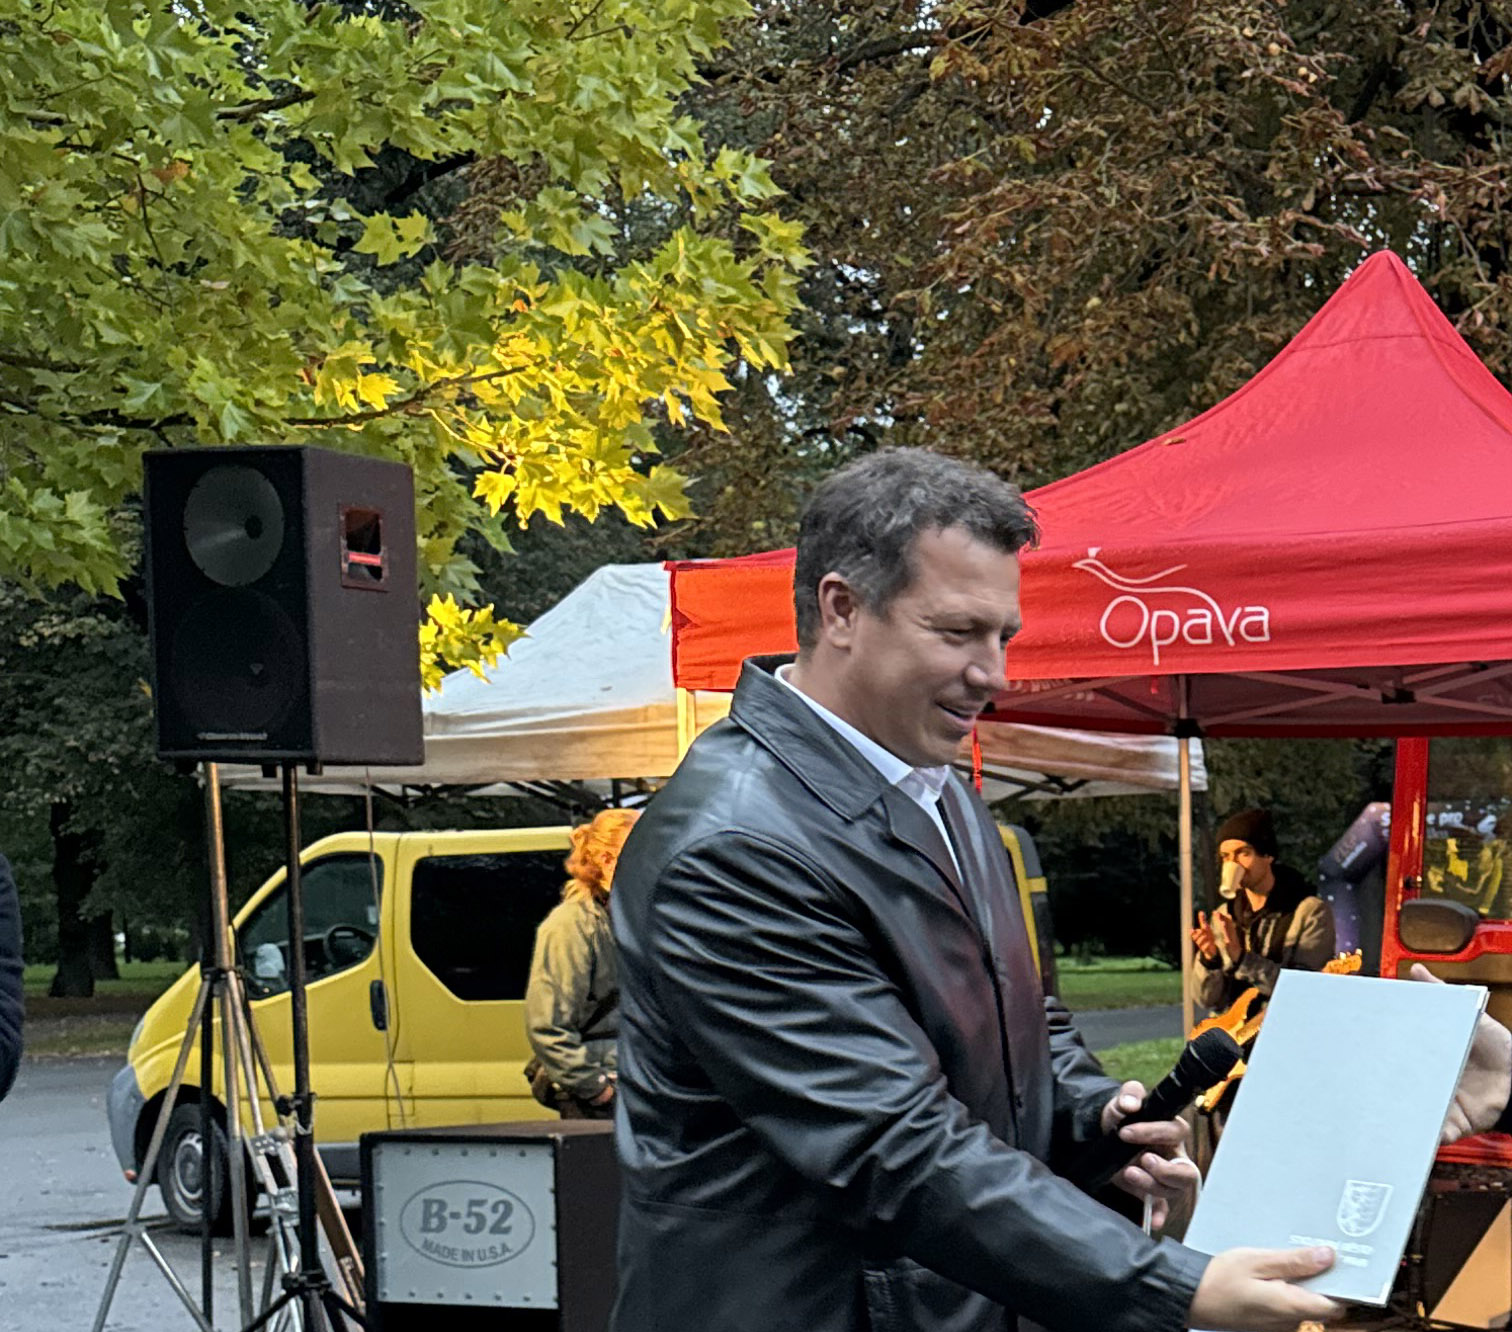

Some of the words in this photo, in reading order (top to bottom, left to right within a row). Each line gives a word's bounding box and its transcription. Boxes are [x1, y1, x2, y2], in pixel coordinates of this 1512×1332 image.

[1099, 594, 1271, 666] Opava
[419, 1198, 514, 1235] B-52
[422, 1237, 459, 1261] MADE
[461, 1248, 475, 1261] IN
